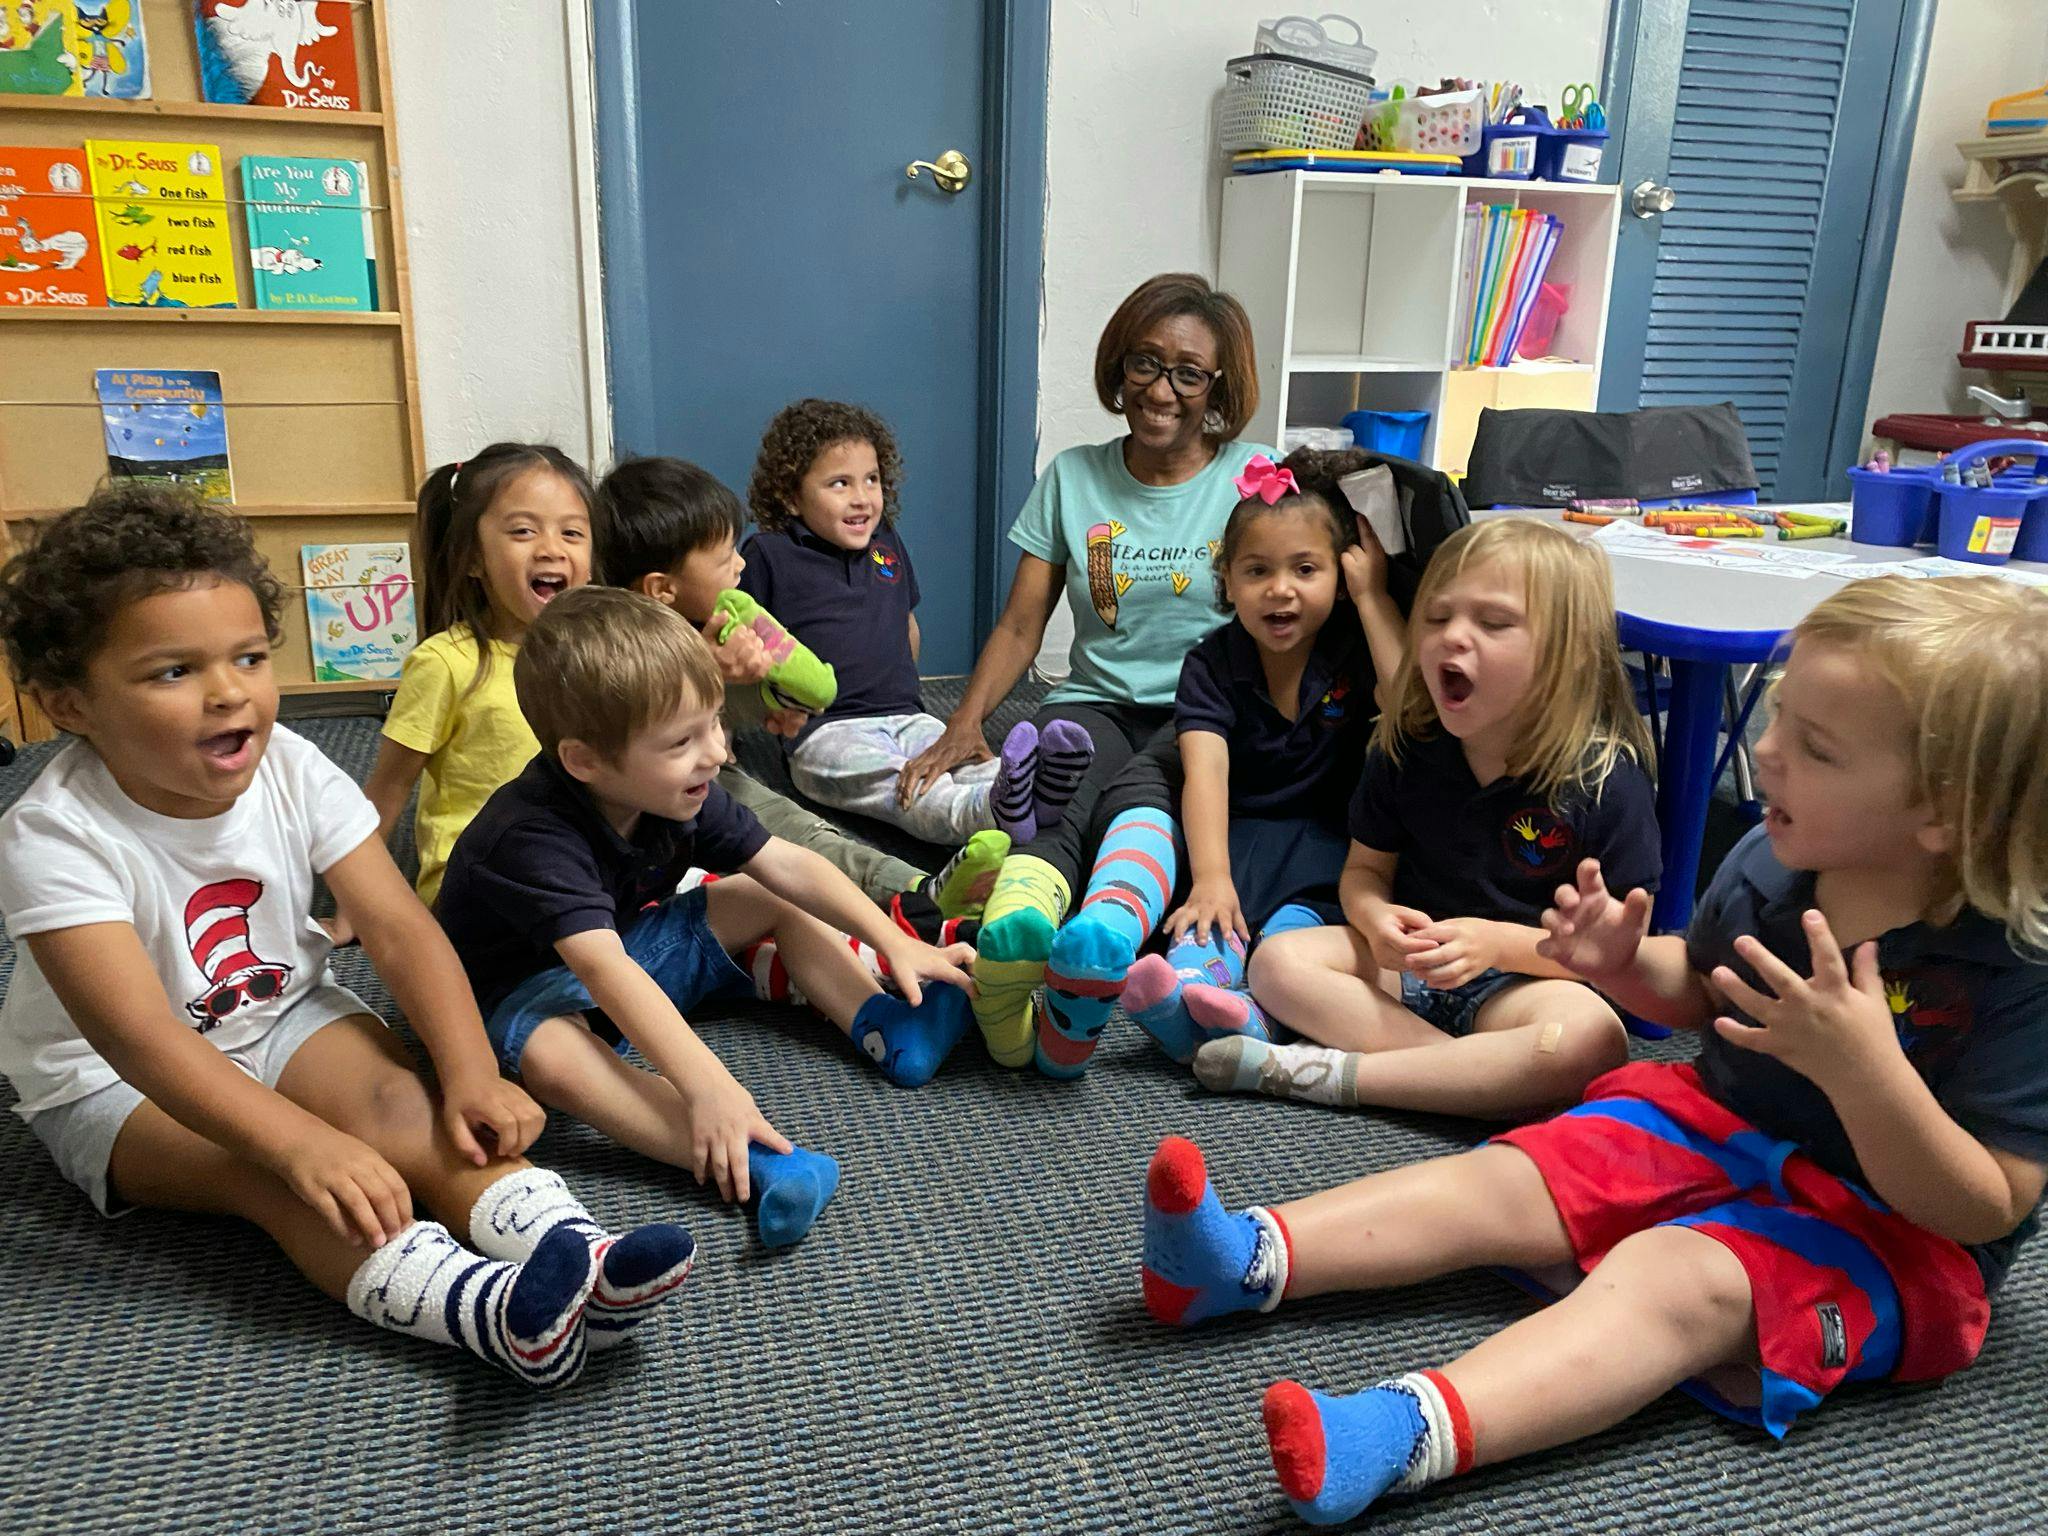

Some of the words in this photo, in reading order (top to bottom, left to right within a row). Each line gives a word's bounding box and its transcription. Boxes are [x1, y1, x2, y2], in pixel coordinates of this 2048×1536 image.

[281, 89, 309, 109] Dr.
[309, 88, 350, 110] Seuss
[108, 153, 135, 171] Dr.
[136, 152, 178, 172] Seuss
[252, 165, 281, 180] Are
[284, 165, 315, 180] You
[160, 187, 182, 198] One
[185, 187, 208, 199] fish
[274, 182, 301, 200] My
[167, 217, 190, 228] two
[193, 217, 216, 229] fish
[168, 245, 186, 255] red
[189, 245, 212, 256] fish
[172, 272, 197, 283] blue
[199, 273, 222, 284] fish
[19, 287, 46, 305] Dr.
[46, 286, 88, 305] Seuss
[307, 548, 349, 574] GREAT
[1112, 542, 1207, 561] TEACHING
[313, 566, 345, 592] DAY
[344, 573, 408, 632] UP
